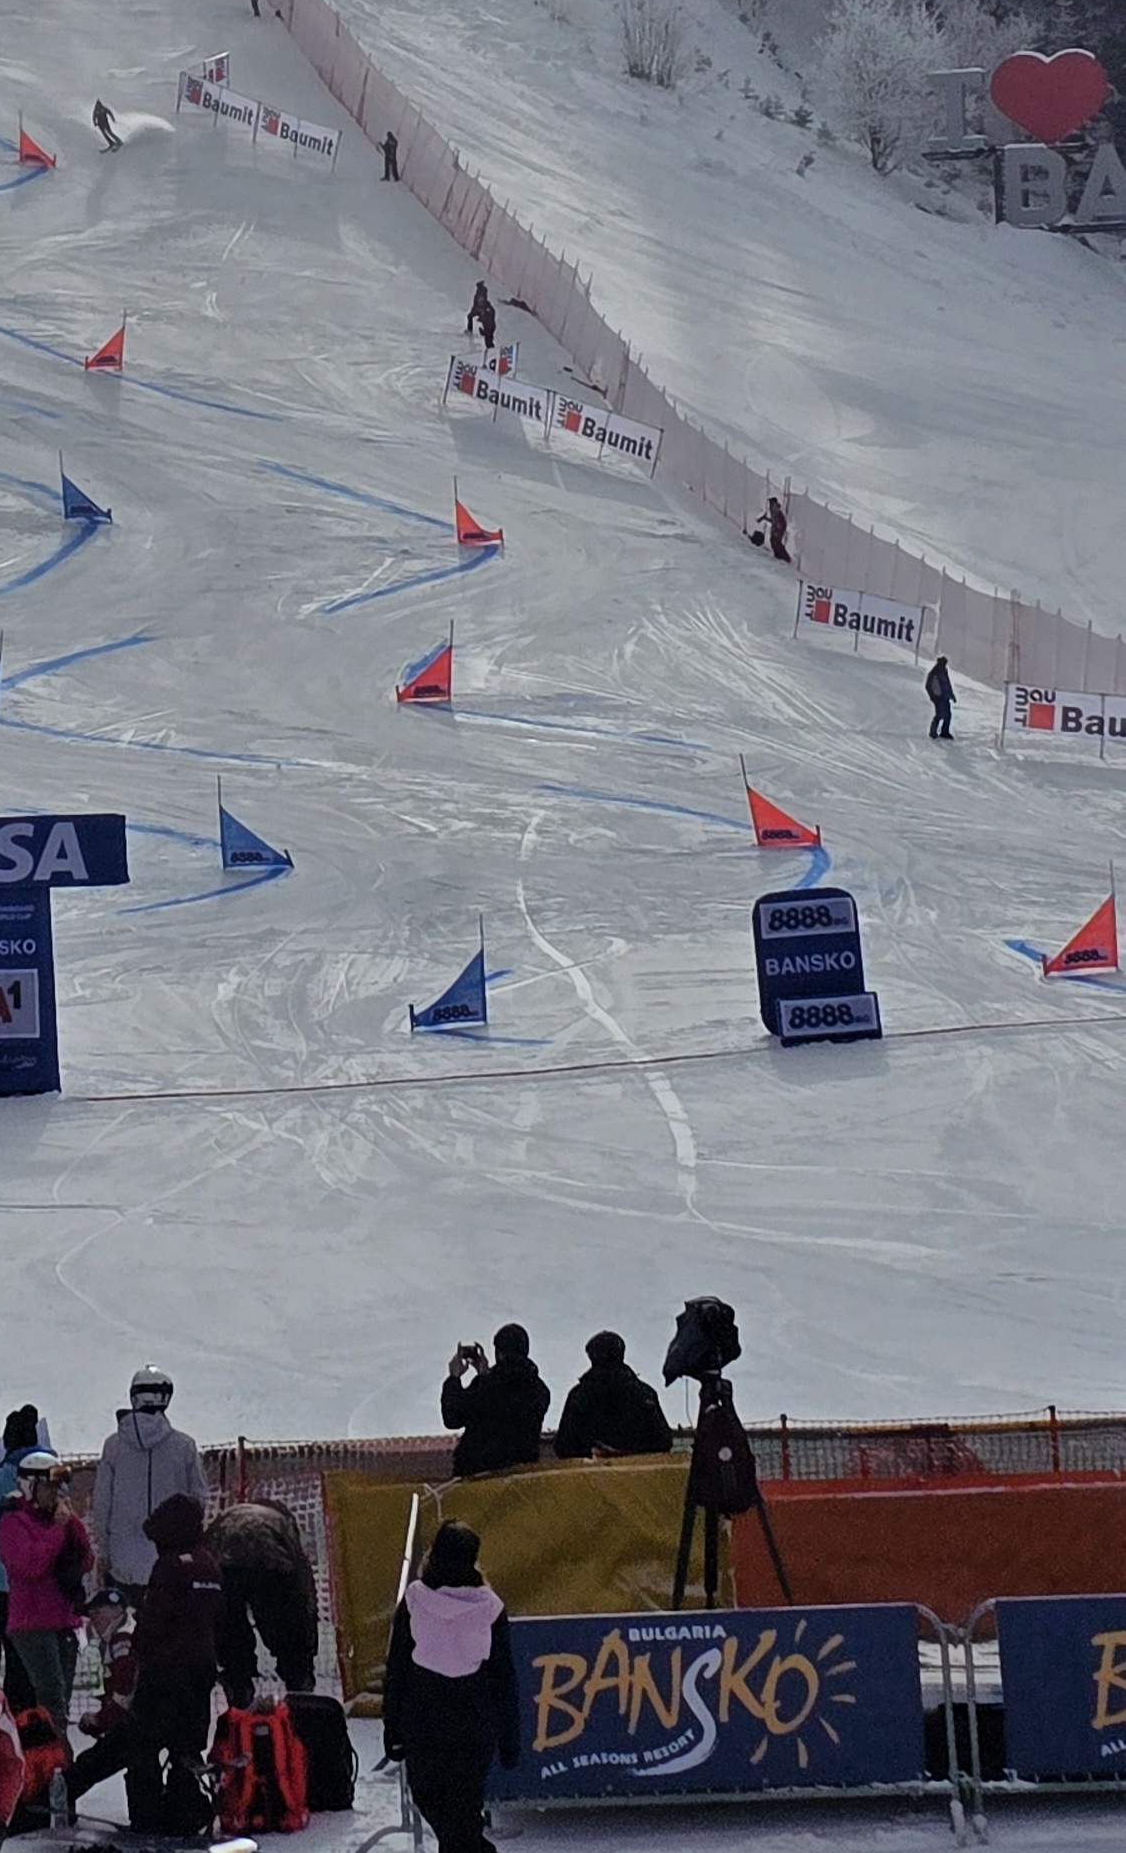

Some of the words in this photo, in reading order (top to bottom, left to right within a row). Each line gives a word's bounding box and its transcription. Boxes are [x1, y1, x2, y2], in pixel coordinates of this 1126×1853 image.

[202, 92, 254, 126] Baumit
[279, 122, 334, 156] Baumit
[476, 379, 542, 421] Baumit
[581, 417, 653, 460] Baumit
[833, 603, 915, 643] Baumit
[765, 950, 856, 976] BANSKO
[628, 1624, 727, 1642] BULGARIA
[532, 1627, 819, 1776] BANSKO
[540, 1762, 568, 1779] ALL
[573, 1752, 638, 1768] SEASONS
[643, 1728, 696, 1763] RESORT
